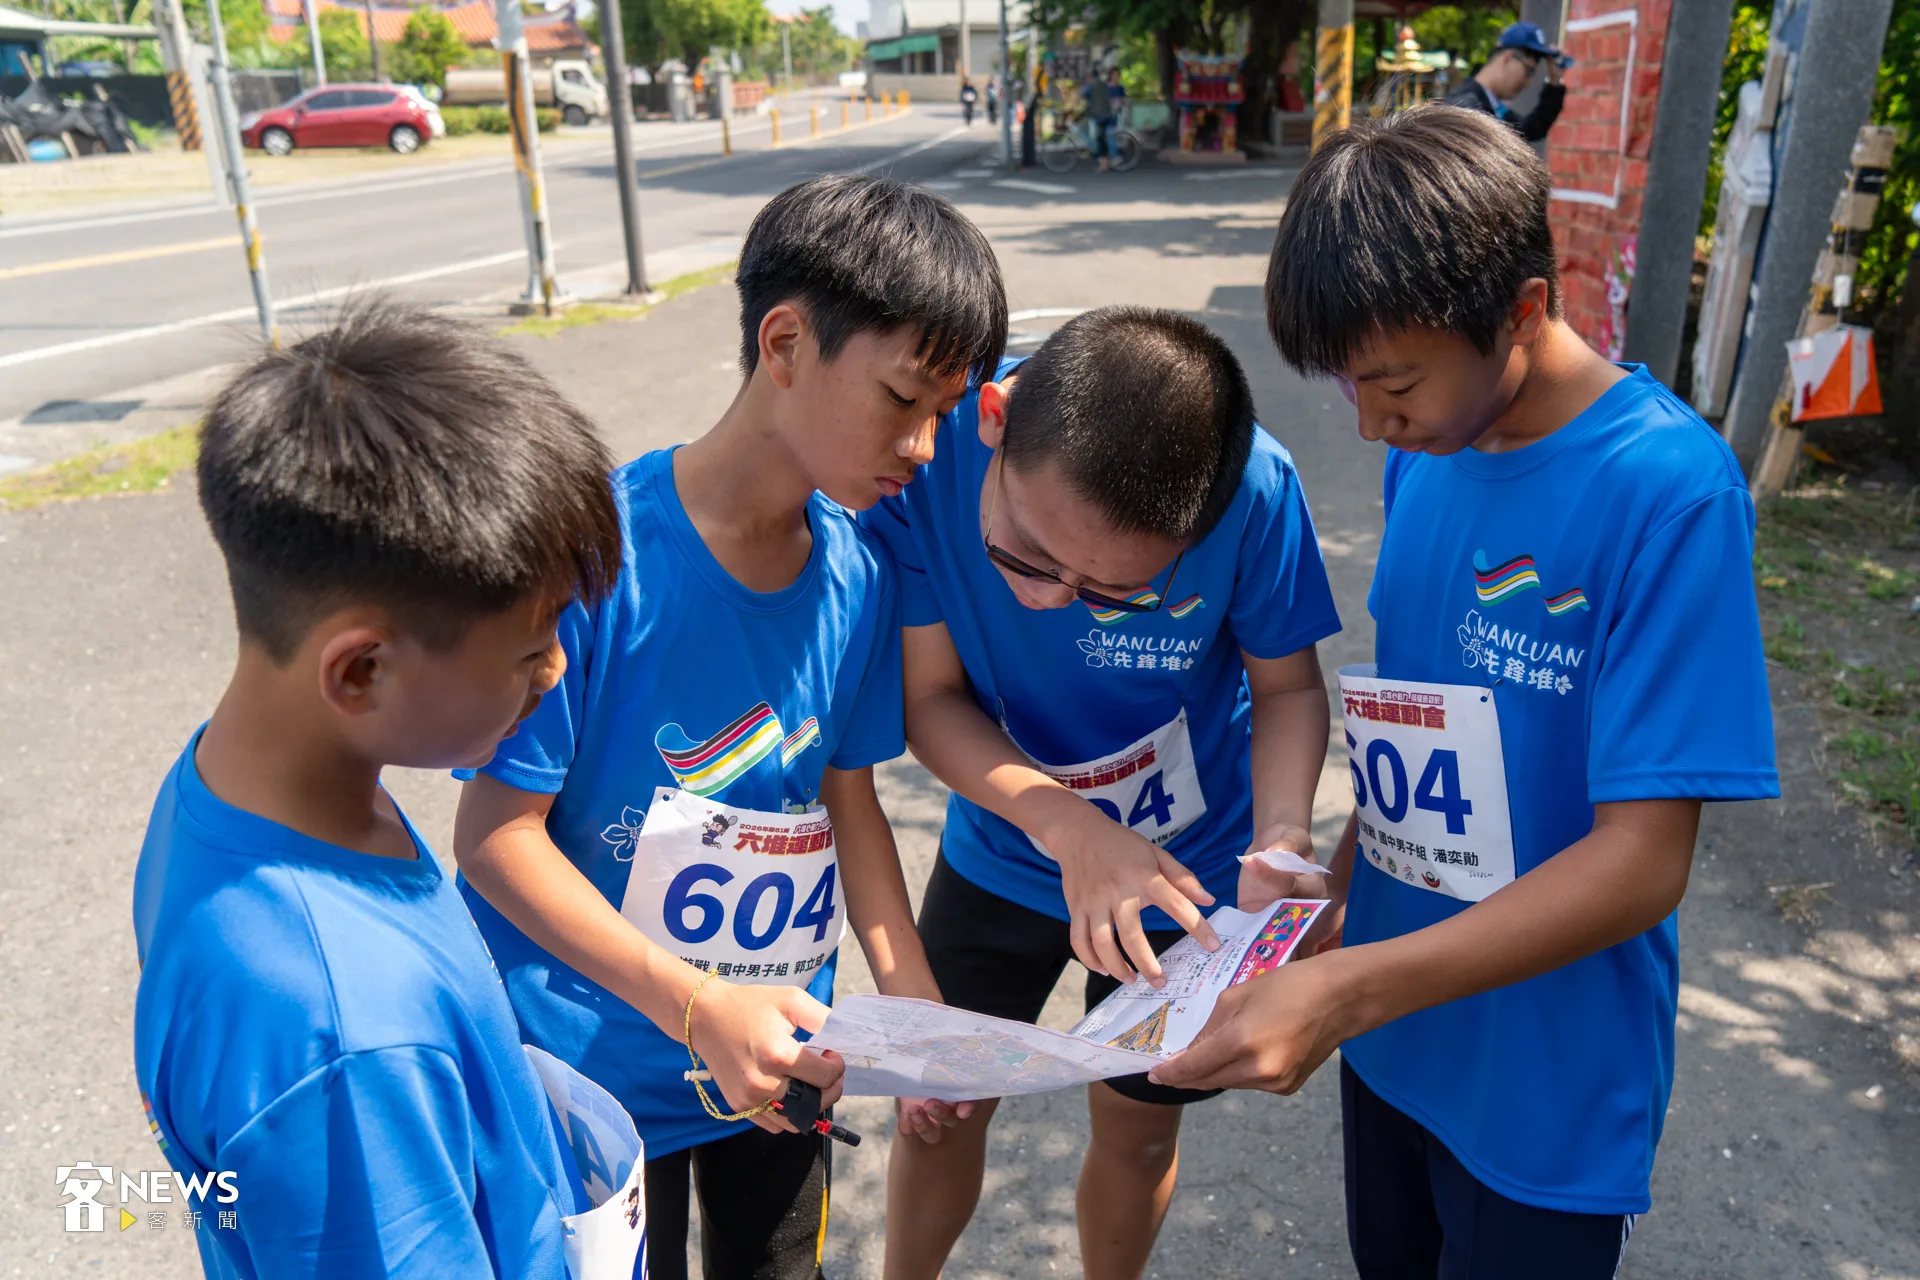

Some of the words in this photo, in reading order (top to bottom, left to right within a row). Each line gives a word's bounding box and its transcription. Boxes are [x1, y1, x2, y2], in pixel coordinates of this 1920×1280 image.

[1102, 632, 1203, 653] WANLUAN
[1478, 616, 1585, 668] WANLUAN
[1113, 651, 1182, 671] 先鋒堆
[1344, 697, 1446, 730] 六堆運動會
[1378, 830, 1427, 861] 國中男子組
[663, 861, 836, 951] 604
[717, 962, 789, 977] 國中男子組
[794, 953, 825, 974] 郭立成
